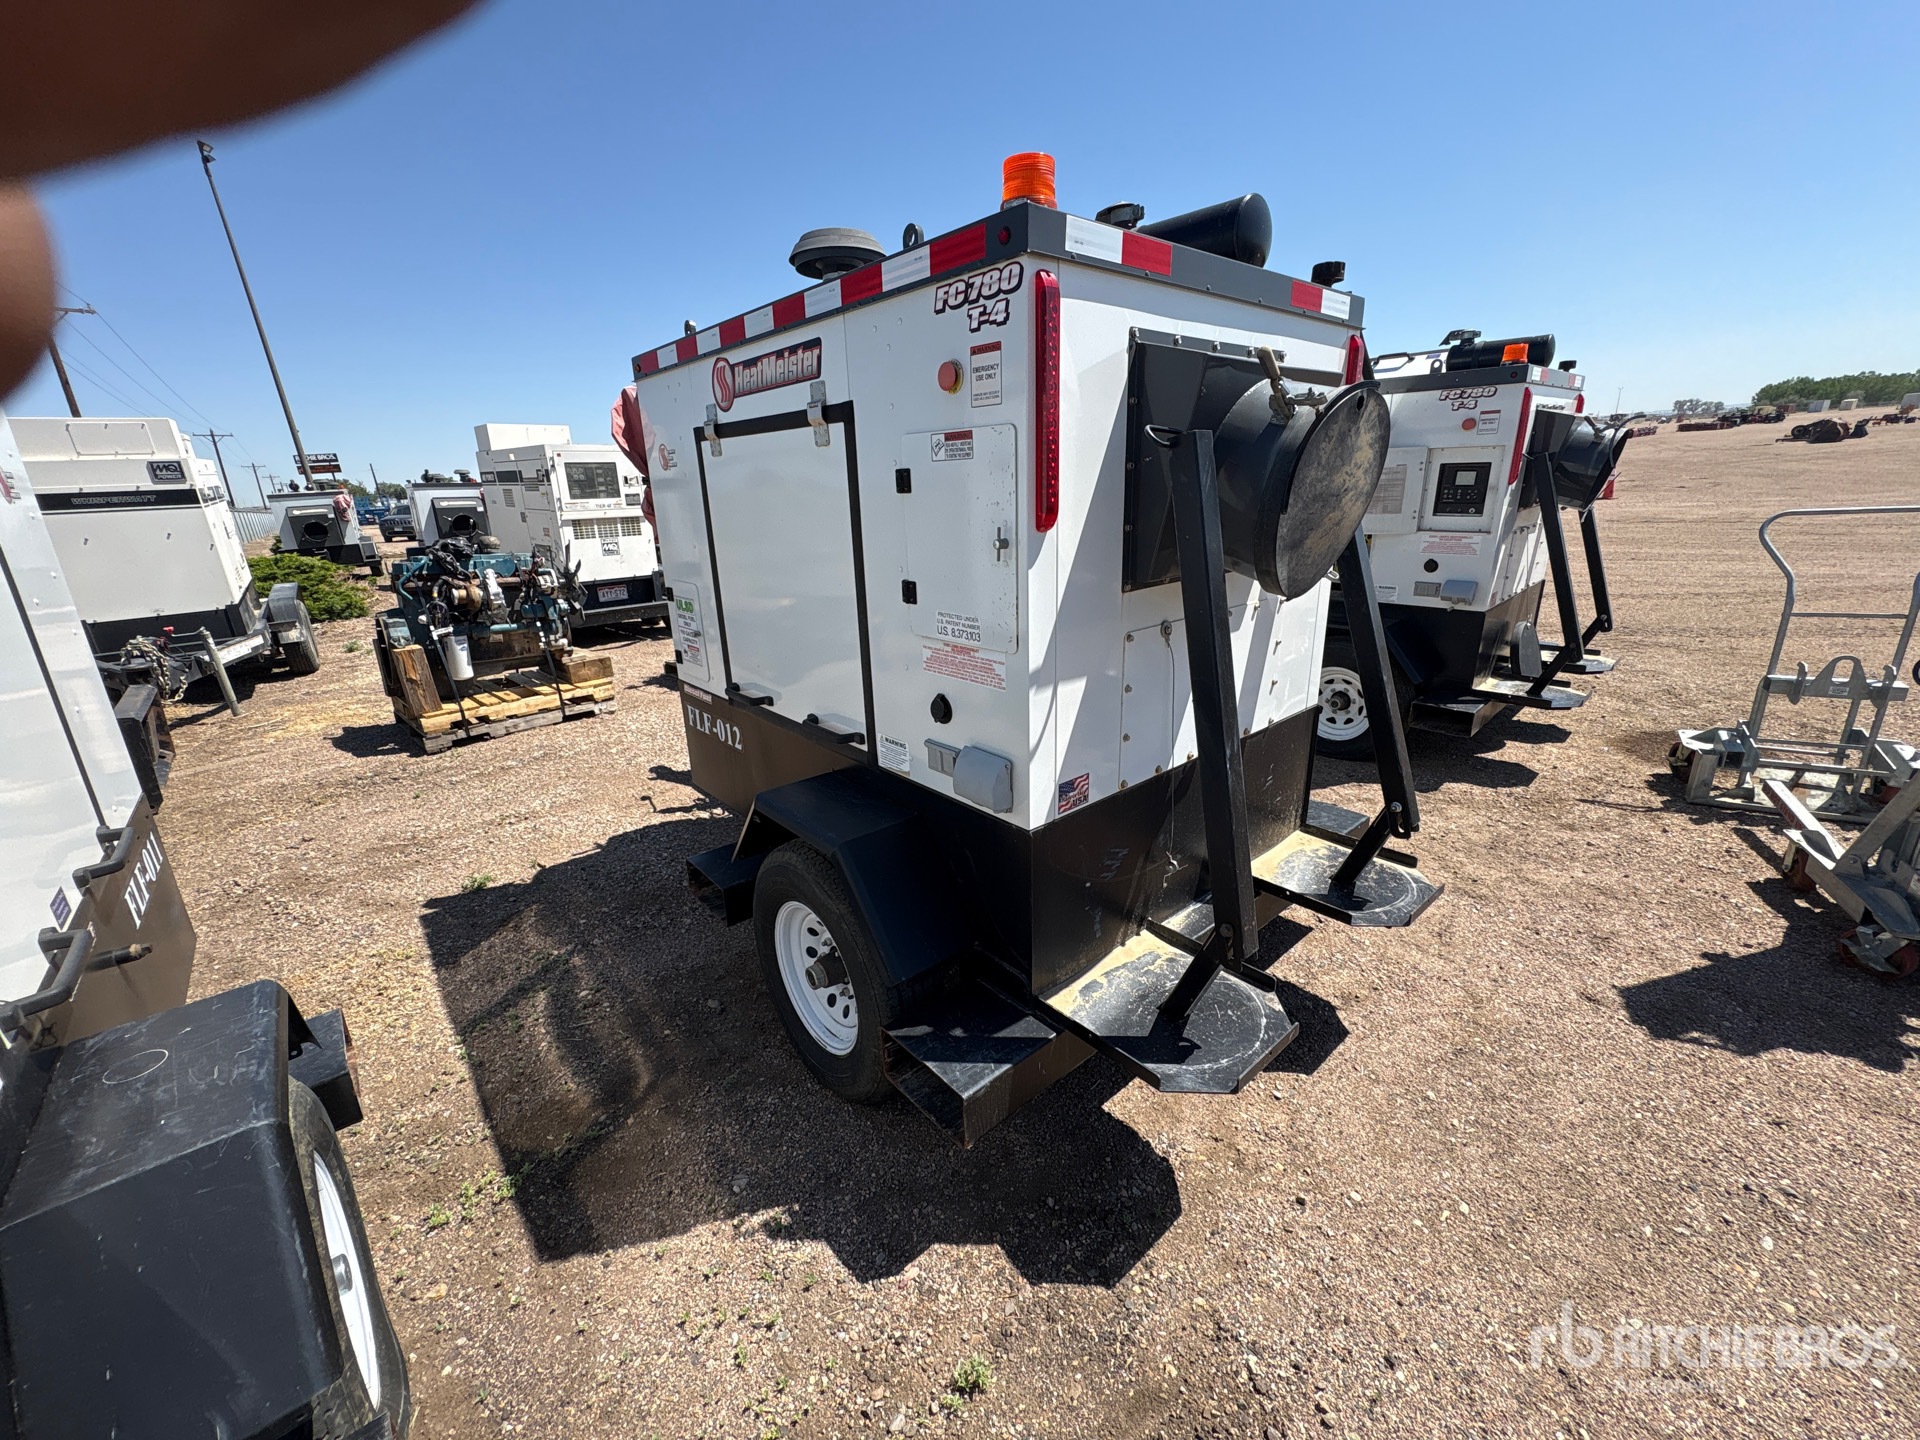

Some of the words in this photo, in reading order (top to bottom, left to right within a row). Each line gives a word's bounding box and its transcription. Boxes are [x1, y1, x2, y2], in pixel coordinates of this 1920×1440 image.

[967, 297, 1010, 333] T-4
[734, 346, 820, 394] HeatMeister
[973, 363, 999, 374] EMERGENCY
[975, 374, 984, 382] USE
[985, 372, 997, 380] ONLY
[1451, 400, 1478, 411] T-4
[155, 464, 180, 473] MQ
[71, 495, 156, 505] WHISPERWATT
[676, 599, 694, 613] ULSD
[938, 611, 963, 621] PROTECTED
[937, 625, 950, 636] U.S.
[951, 628, 981, 642] 8,373,103
[687, 704, 743, 751] FLF-012
[124, 831, 164, 930] FLF-011
